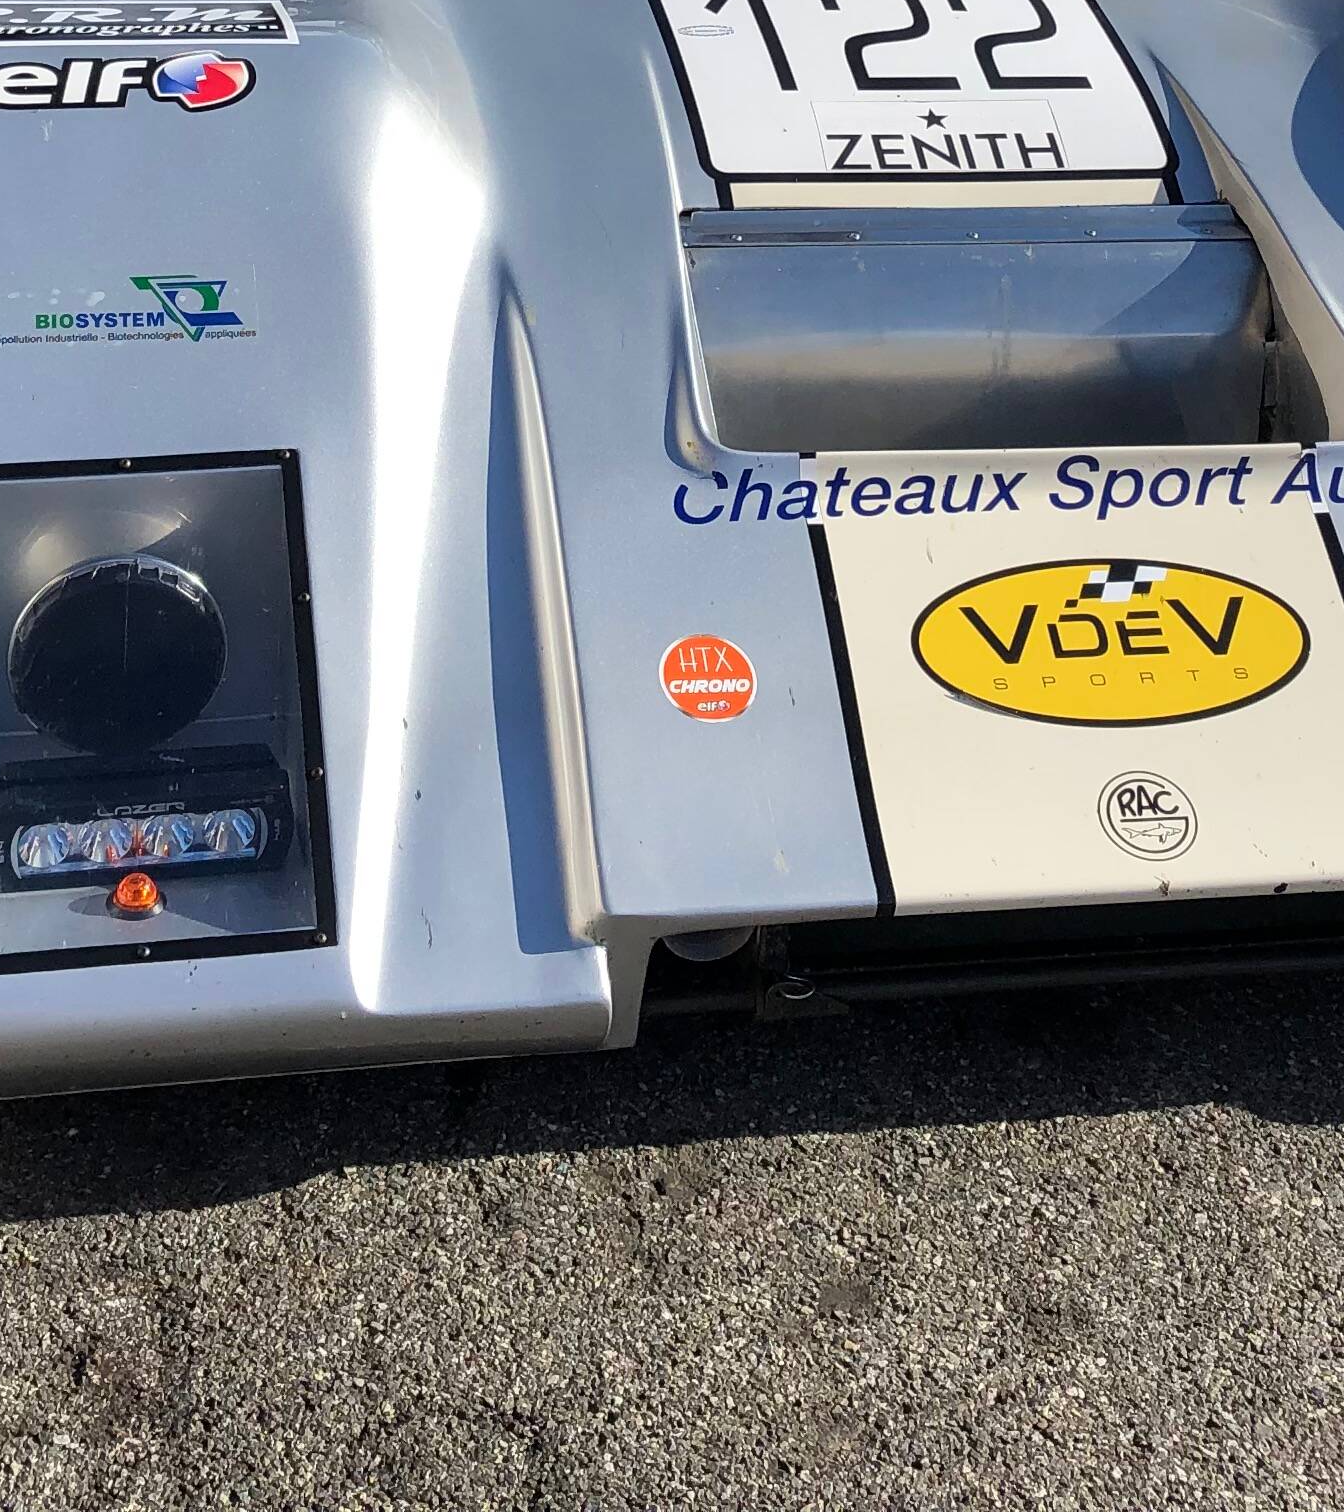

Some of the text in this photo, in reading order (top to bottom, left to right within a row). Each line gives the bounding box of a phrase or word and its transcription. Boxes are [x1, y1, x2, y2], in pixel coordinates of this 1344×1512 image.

[825, 130, 1065, 170] ZENITH
[34, 311, 166, 330] BIOSYSTEM
[107, 330, 185, 343] Biotechnologies
[673, 472, 1026, 526] Chateaux
[1048, 455, 1252, 519] Sport
[959, 596, 1244, 665] VDEV
[678, 646, 734, 673] HTX
[669, 678, 751, 694] CHRONO
[993, 666, 1249, 691] SPORTS
[697, 701, 718, 712] elf
[96, 801, 185, 817] LAZER
[1116, 784, 1180, 818] RAC
